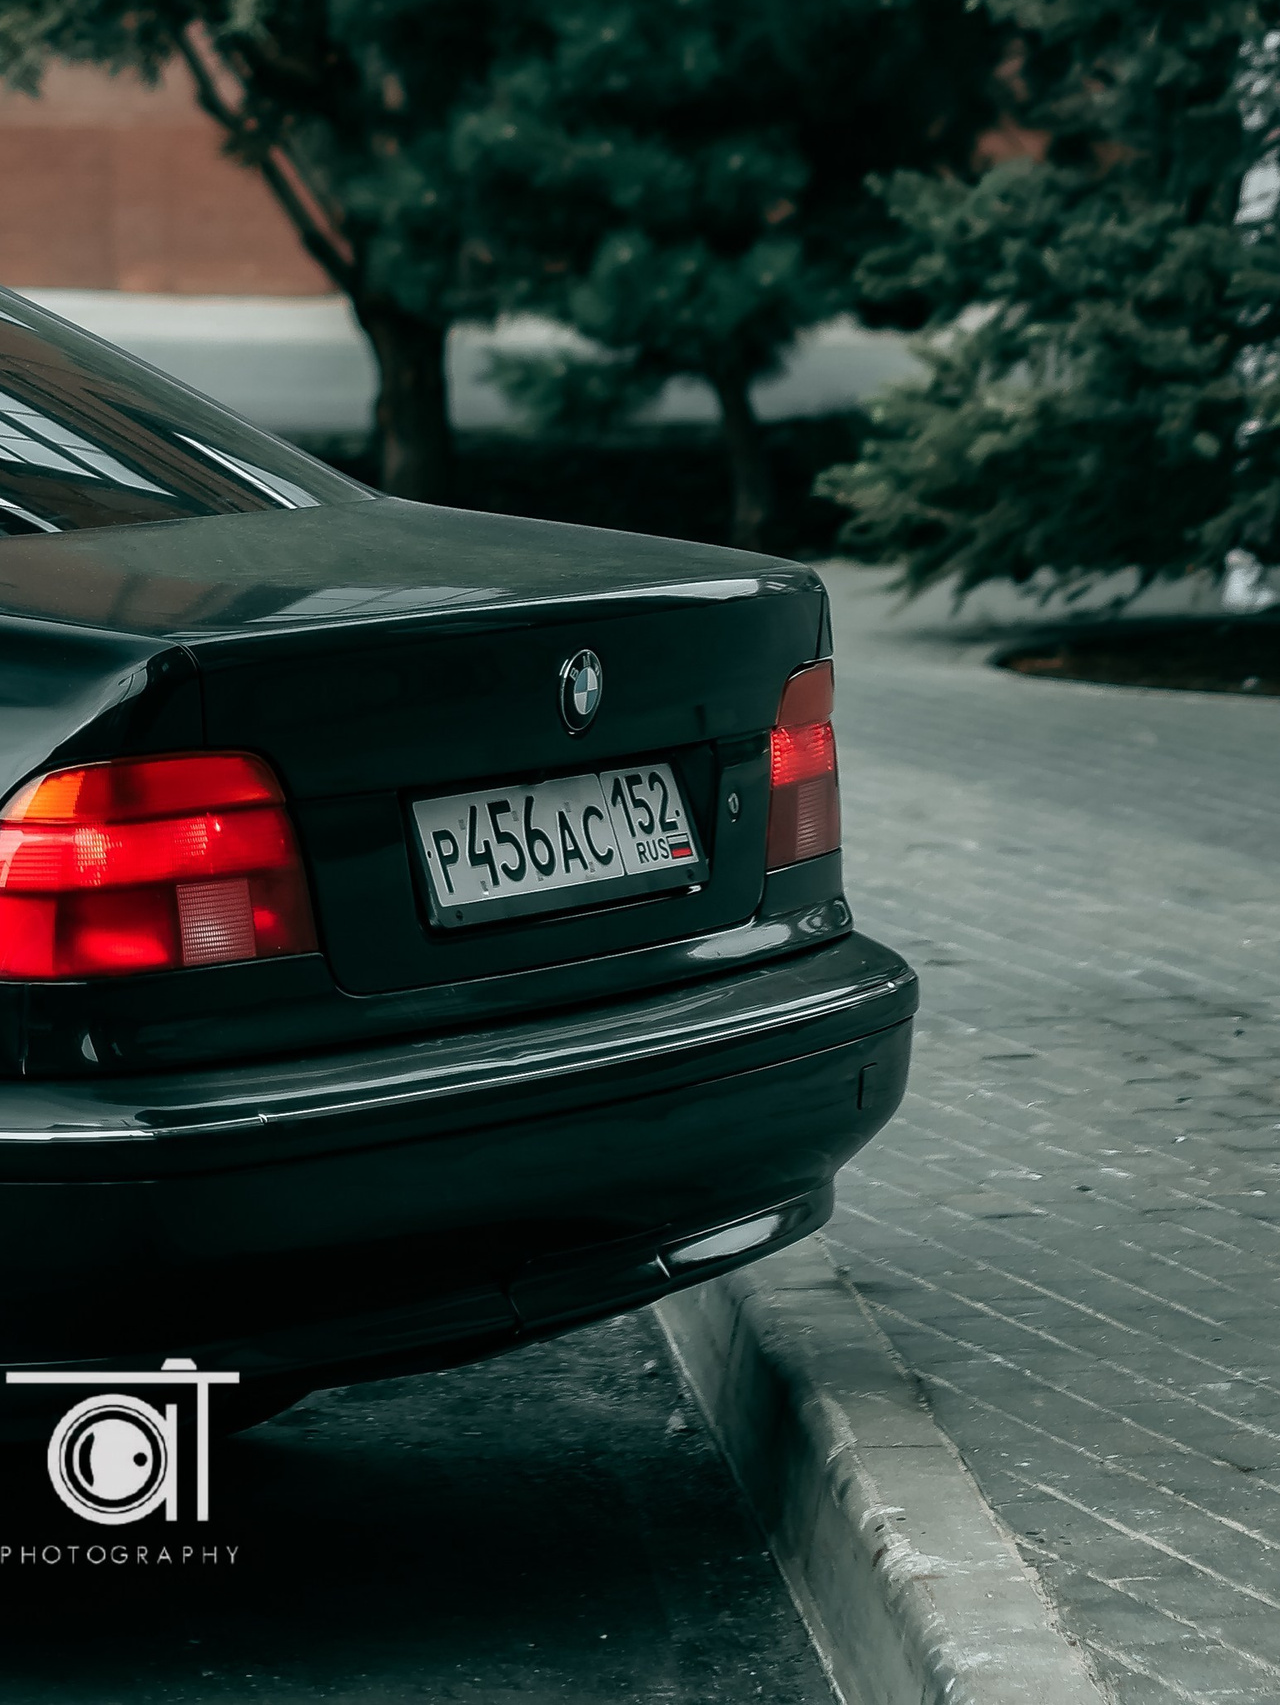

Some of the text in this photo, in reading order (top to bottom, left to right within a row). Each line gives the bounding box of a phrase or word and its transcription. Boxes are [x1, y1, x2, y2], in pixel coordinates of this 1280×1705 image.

[431, 771, 677, 894] P456AC 152
[636, 838, 669, 863] RUS
